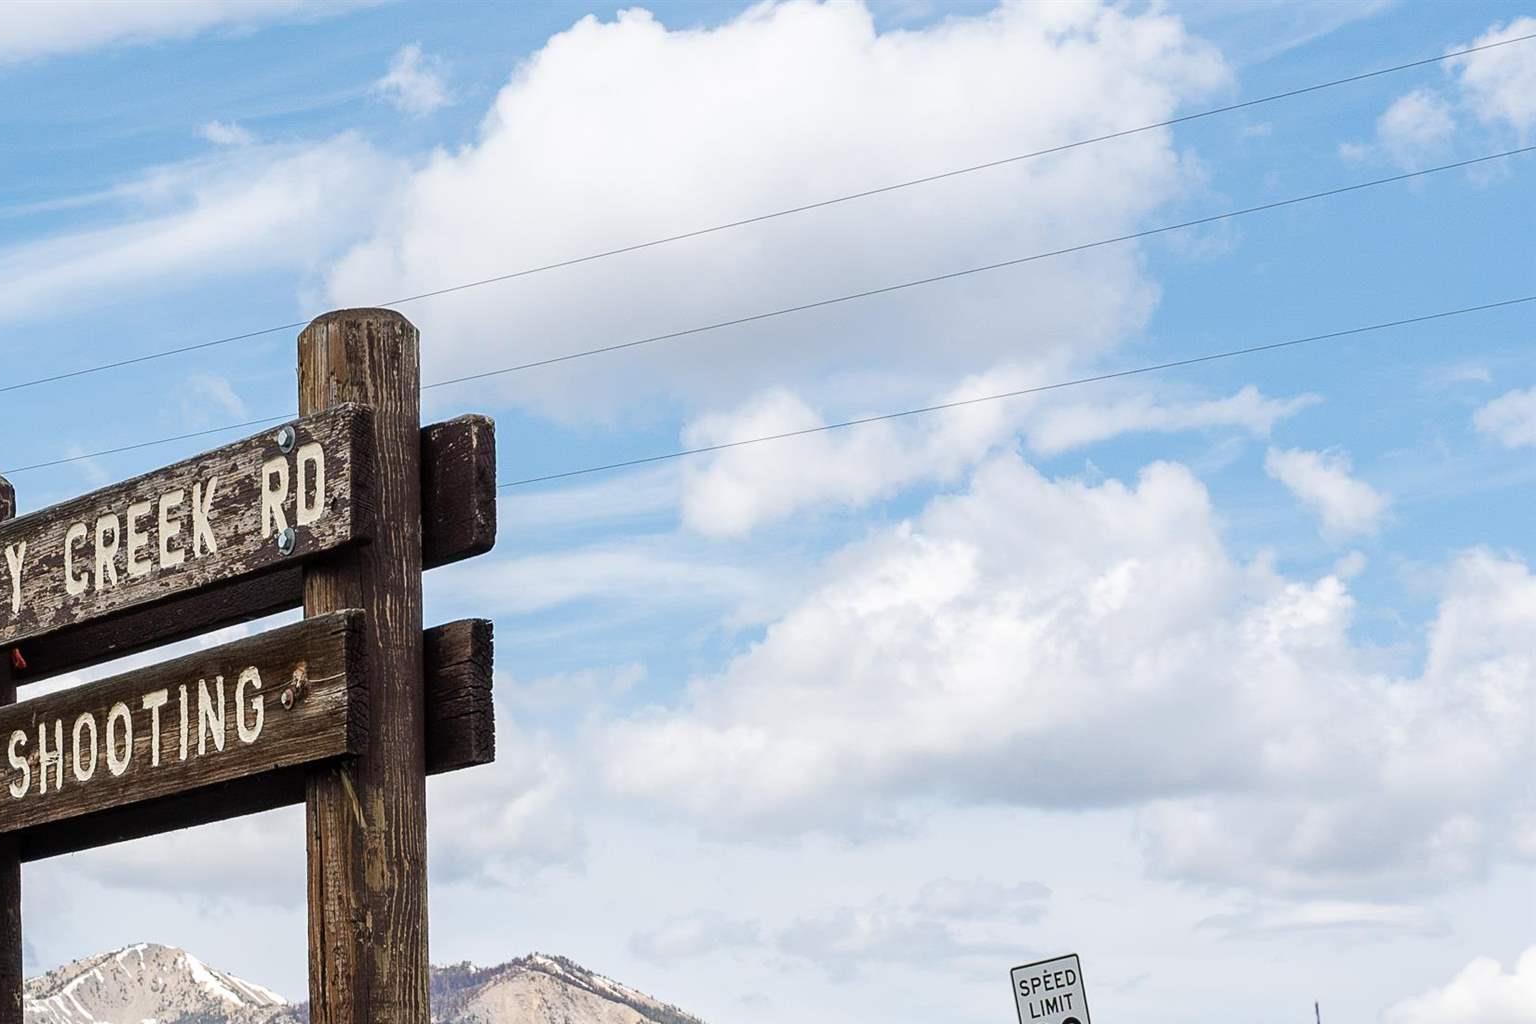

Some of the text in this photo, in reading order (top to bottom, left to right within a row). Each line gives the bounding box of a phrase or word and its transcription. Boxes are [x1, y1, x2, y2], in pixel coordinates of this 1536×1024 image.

[63, 475, 218, 597] CREEK
[261, 442, 326, 540] RD
[8, 665, 265, 799] SHOOTING
[1019, 969, 1077, 997] SPEED
[1029, 993, 1073, 1019] LIMIT
